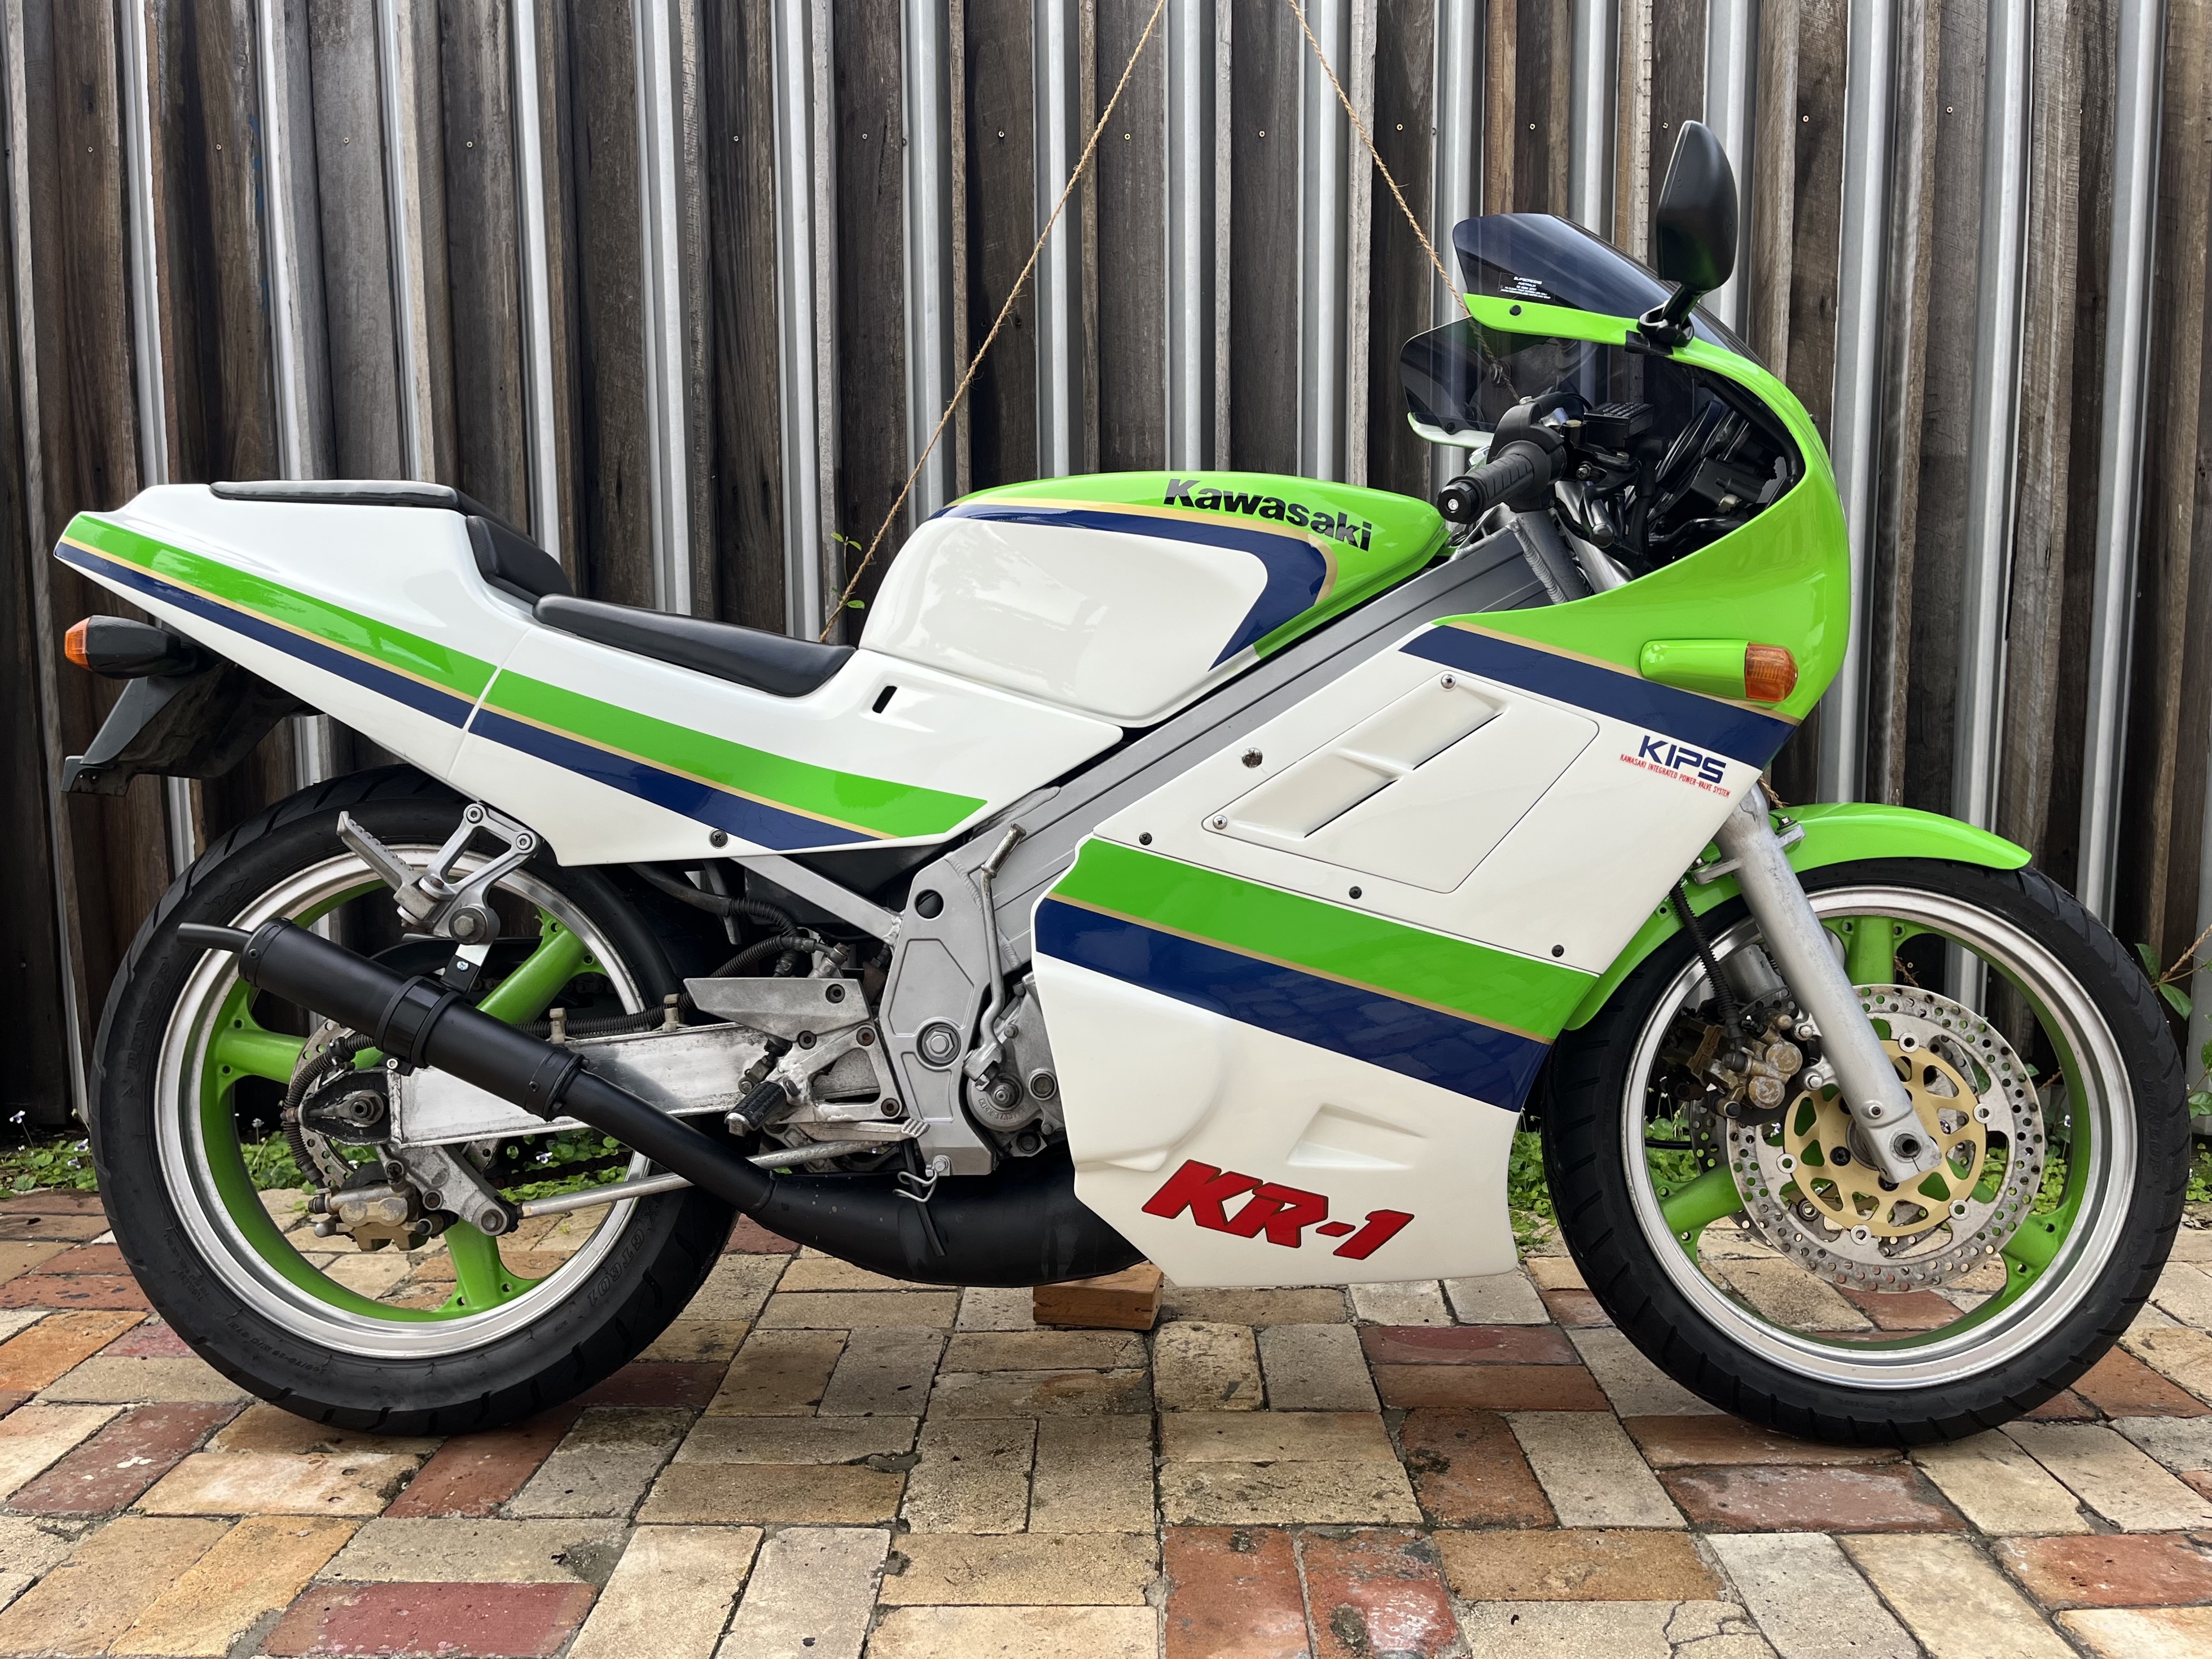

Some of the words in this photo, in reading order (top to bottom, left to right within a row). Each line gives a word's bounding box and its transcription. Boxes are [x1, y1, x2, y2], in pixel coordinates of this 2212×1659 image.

[1164, 479, 1372, 552] Kawasaki
[1620, 753, 1647, 767] KAWASAKI
[1647, 763, 1678, 779] INTEGRATED
[1679, 774, 1713, 791] POWER-VALVE
[1713, 786, 1730, 797] SYSTEM
[1638, 735, 1727, 784] KIPS
[978, 1098, 994, 1116] KICK
[1142, 1159, 1415, 1260] KR-1
[586, 1228, 646, 1307] GT601
